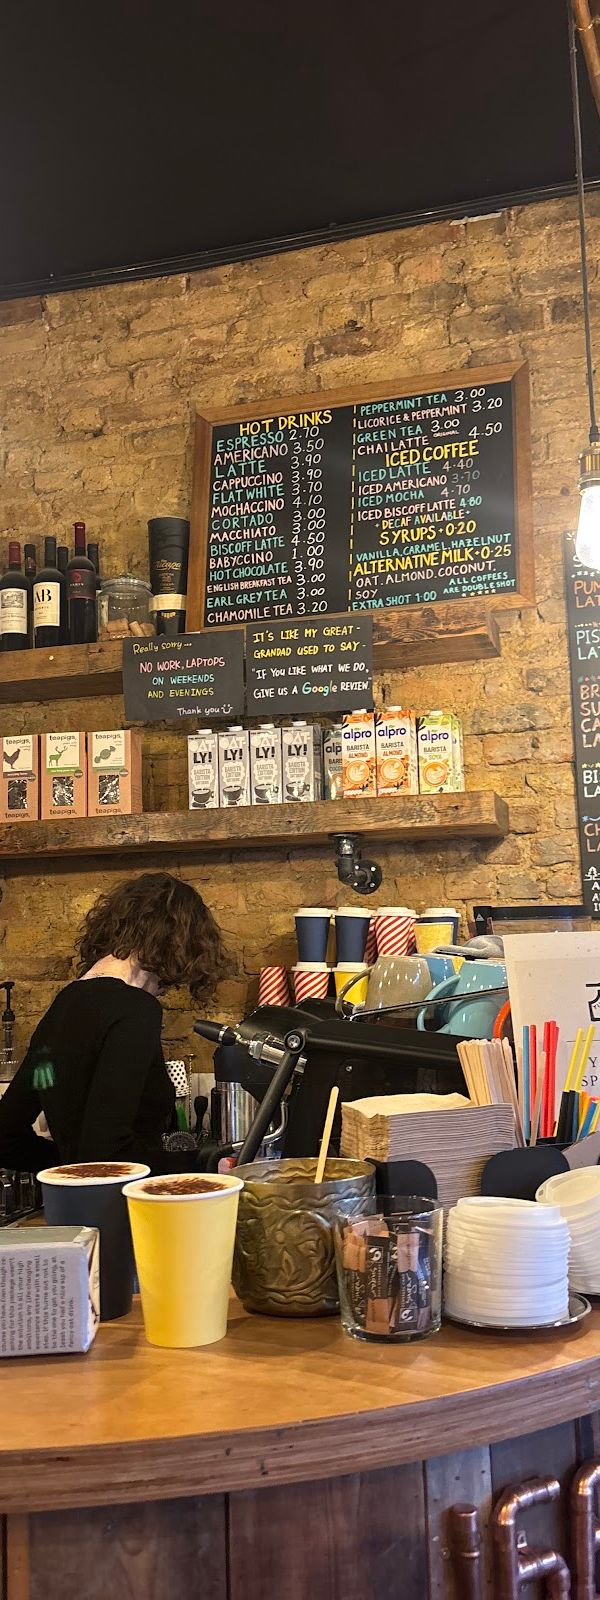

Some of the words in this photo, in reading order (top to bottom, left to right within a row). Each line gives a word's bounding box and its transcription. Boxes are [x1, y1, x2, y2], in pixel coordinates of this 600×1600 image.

[360, 397, 423, 416] PEPPERMINT
[426, 394, 447, 405] TEA
[454, 387, 485, 403] 3.00
[239, 419, 274, 436] HOT
[279, 410, 332, 430] DRINKS
[358, 414, 401, 429] LICORICE
[403, 413, 410, 422] &
[412, 403, 467, 421] PEPPERMINT
[472, 397, 503, 412] 3.20
[217, 432, 284, 452] ESPRESSO
[289, 426, 319, 440] 2.70
[358, 429, 397, 443] GREEN
[401, 425, 423, 437] TEA
[431, 419, 460, 433] 3.00
[358, 444, 388, 455] CHAI
[391, 436, 429, 452] LATTE
[468, 422, 502, 440] 4.50
[214, 443, 288, 466] AMERICANO
[293, 439, 324, 454] 3.50
[385, 449, 420, 467] ICED
[423, 440, 479, 460] COFFEE
[215, 460, 267, 478] LATTE
[291, 454, 321, 469] 3.90
[358, 469, 387, 482] ICED
[389, 461, 431, 479] LATTE
[213, 472, 283, 492] CAPPUCCINO
[291, 469, 322, 483] 3.90
[359, 484, 383, 496] ICED
[385, 475, 447, 493] AMERICANO
[213, 489, 243, 504] FLAT
[246, 483, 285, 499] WHITE
[292, 482, 322, 496] 3.70
[358, 495, 383, 508] ICED
[386, 489, 424, 503] MOCHA
[211, 499, 285, 518] MOCHACCINO
[293, 495, 322, 508] 4.10
[358, 509, 382, 521] ICED
[385, 504, 426, 518] BISCOFF
[427, 499, 456, 514] LATTE
[212, 513, 273, 530] CORTADO
[292, 508, 325, 522] 3.00
[382, 516, 412, 530] DECAF
[414, 510, 464, 526] AVAILABLE
[210, 525, 276, 543] MACCHIATO
[292, 519, 325, 534] 3.00
[379, 525, 436, 545] SYRUPS
[452, 533, 512, 549] HAZELNUT
[211, 542, 252, 557] BISCOFF
[255, 536, 285, 550] LATTE
[291, 532, 325, 546] 4.50
[209, 552, 273, 569] BABYCCINO
[292, 545, 324, 559] 1.00
[353, 552, 439, 577] ALTERNATIVE
[442, 547, 474, 565] MILK
[210, 570, 234, 581] HOT
[233, 562, 288, 579] CHOCOLATE
[295, 558, 324, 573] 3.90
[449, 577, 468, 586] ALL
[471, 572, 508, 583] COFFEES
[207, 581, 239, 593] ENGLISH
[240, 578, 276, 590] BREAKFAST
[278, 576, 292, 585] TEA
[297, 573, 325, 586] 3.00
[443, 586, 459, 594] ARE
[462, 581, 495, 592] DOUBLE
[496, 579, 516, 588] SHOT
[207, 596, 234, 609] EARL
[236, 592, 264, 605] GREY
[266, 589, 287, 602] TEA
[297, 587, 325, 600] 3.00
[352, 598, 384, 611] EXTRA
[386, 594, 411, 606] SHOT
[355, 589, 378, 600] SOY
[208, 607, 271, 623] CHAMOMILE
[273, 604, 293, 618] TEA
[297, 601, 328, 614] 3.20
[253, 630, 274, 643] IT'S
[281, 629, 299, 640] LIKE
[305, 629, 317, 639] MY
[133, 642, 158, 655] Really
[253, 647, 291, 659] GRANDAD
[298, 646, 318, 656] USED
[323, 644, 335, 653] TO
[139, 662, 153, 673] NO
[157, 660, 185, 672] WORK,
[186, 657, 225, 669] LAPTOPS
[288, 666, 306, 675] LIKE
[311, 664, 332, 674] WHAT
[339, 663, 351, 673] WE
[353, 662, 369, 673] DO,
[152, 677, 164, 685] ON
[170, 674, 215, 684] WEEKENDS
[148, 690, 164, 699] AND
[169, 687, 214, 697] EVENINGS
[253, 687, 275, 699] GIVE
[278, 686, 288, 696] US
[292, 685, 298, 694] A
[302, 681, 338, 697] Google
[177, 706, 202, 716] Thank
[205, 707, 220, 716] you
[344, 728, 372, 741] alpro
[378, 726, 406, 738] alpro
[421, 730, 449, 743] alpro
[194, 752, 212, 763] LY!
[224, 749, 243, 760] LY!
[256, 747, 275, 758] LY!
[288, 744, 307, 756] LY!
